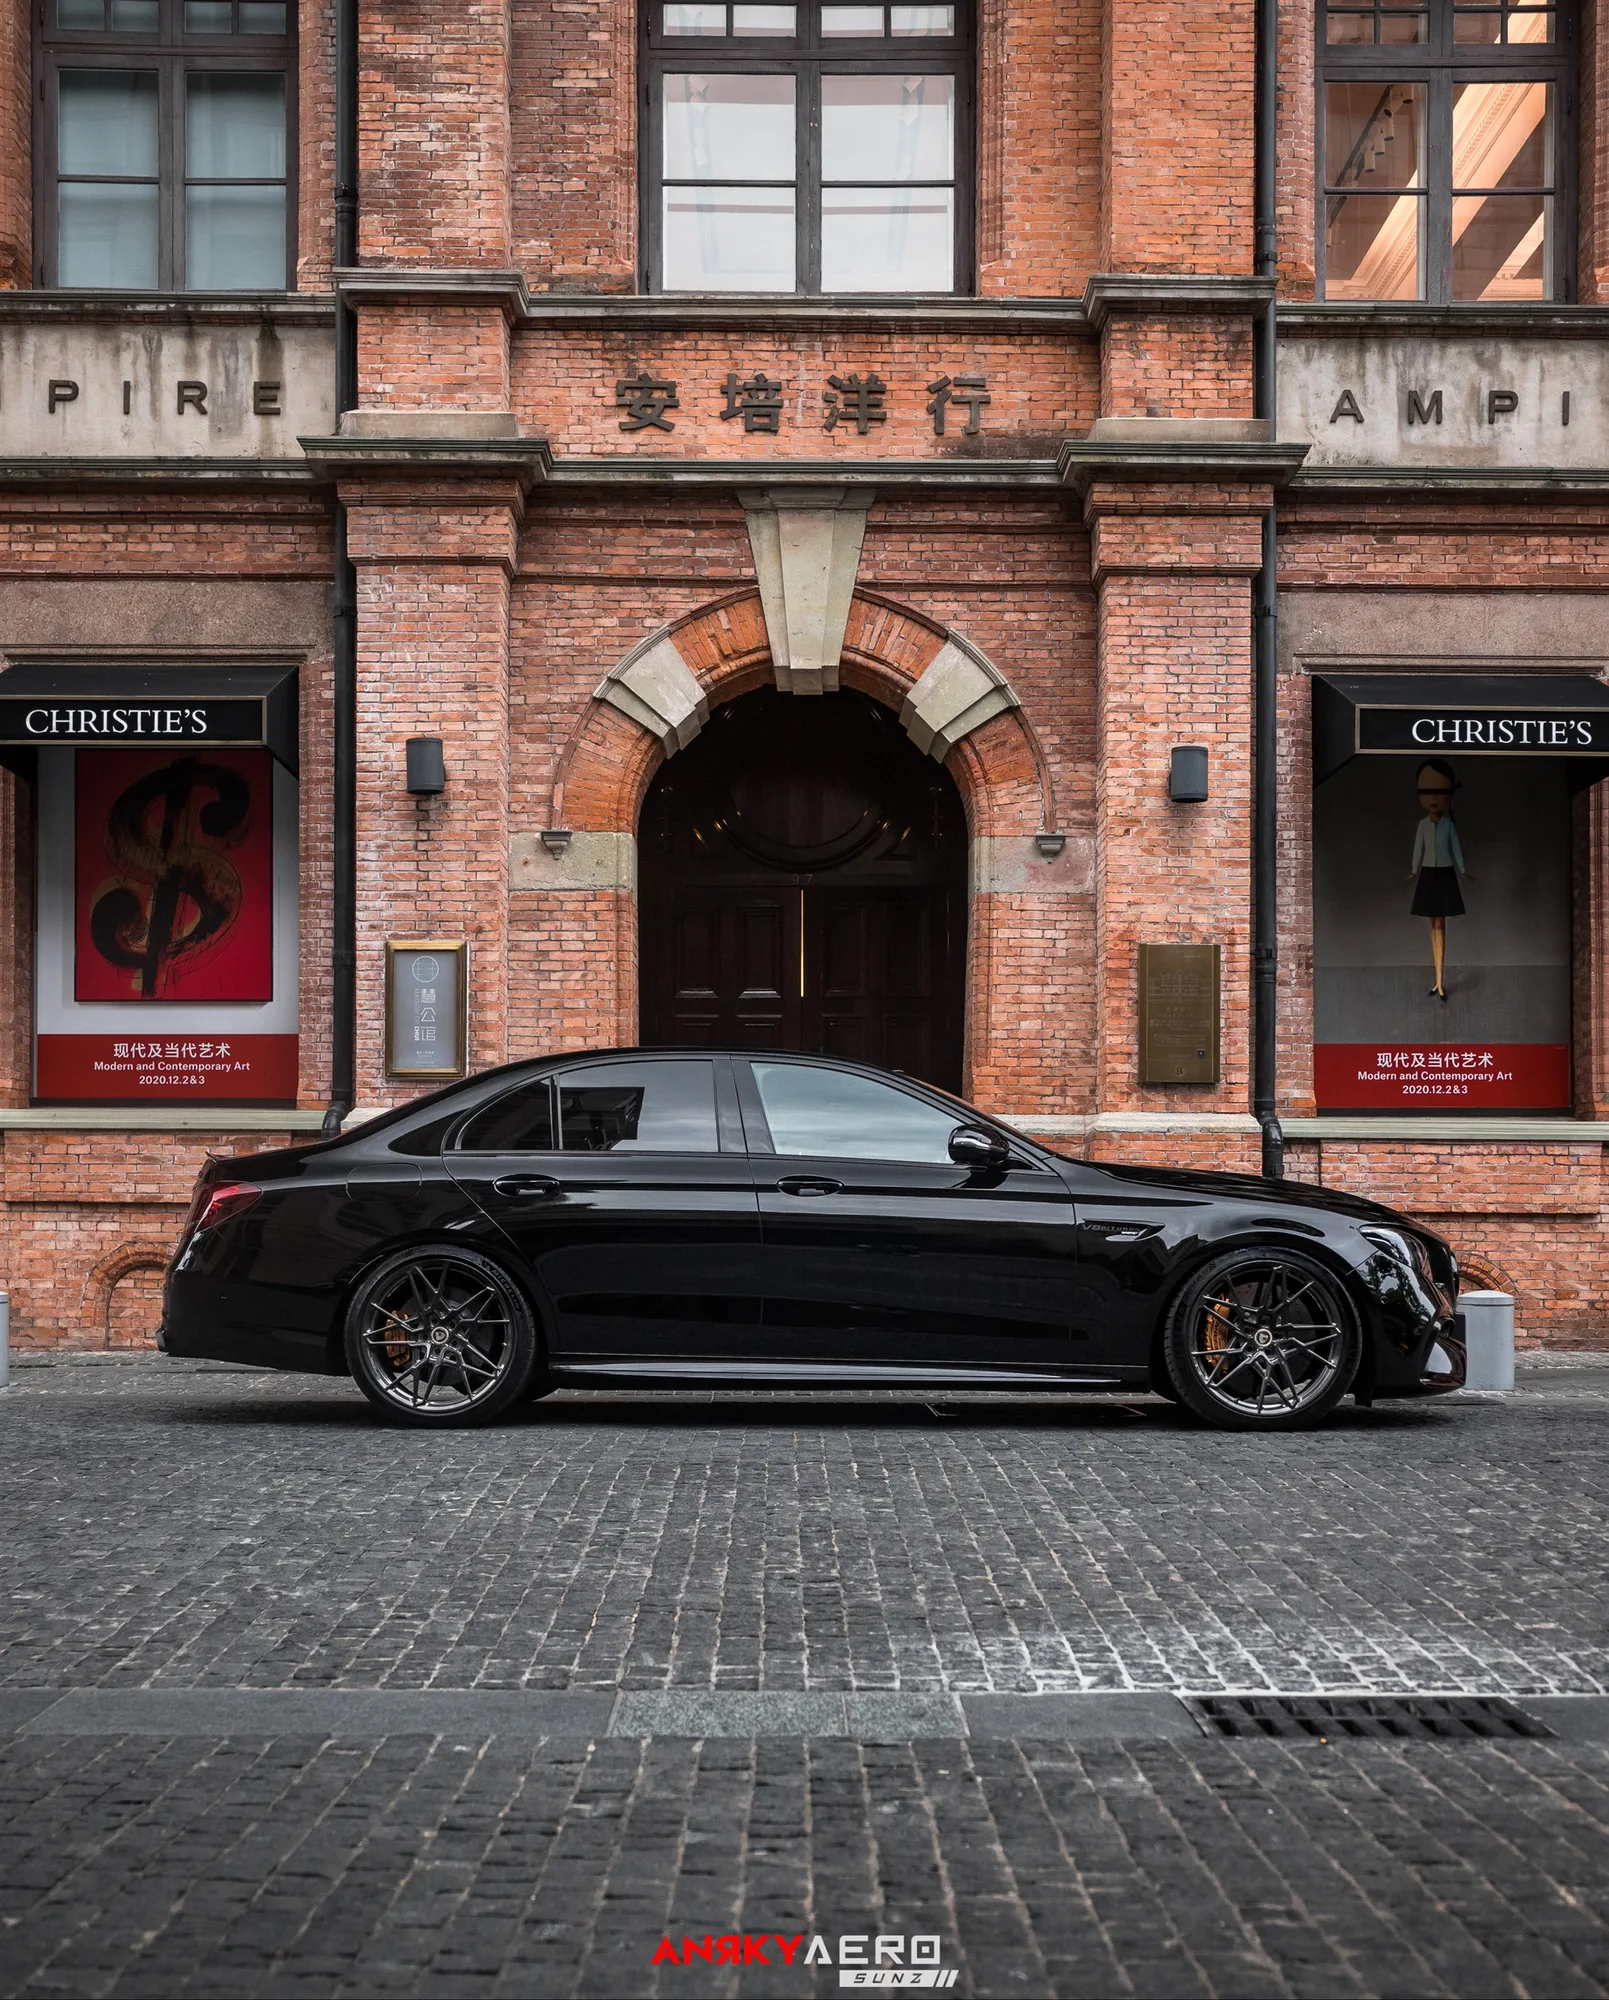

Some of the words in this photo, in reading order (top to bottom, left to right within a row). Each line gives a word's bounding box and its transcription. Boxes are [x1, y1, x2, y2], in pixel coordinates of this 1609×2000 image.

[0, 379, 281, 415] PIRE
[615, 372, 992, 435] 安培洋行
[1329, 389, 1571, 425] AMPI
[25, 708, 208, 734] CHRISTIE'S
[1411, 718, 1593, 745] CHRISTIE'S
[791, 873, 814, 885] 97
[113, 1042, 231, 1058] 现代及当代艺术
[94, 1062, 133, 1071] Modern
[136, 1062, 155, 1071] and
[157, 1062, 231, 1072] Contemporary
[234, 1062, 250, 1071] Art
[1376, 1052, 1494, 1068] 现代及当代艺术
[139, 1075, 205, 1085] 2020.12.2&3
[1357, 1071, 1397, 1080] Modern
[1399, 1071, 1418, 1080] and
[1421, 1071, 1494, 1082] Contemporary
[1496, 1071, 1513, 1080] Art
[1402, 1085, 1468, 1094] 2020.12.2&3
